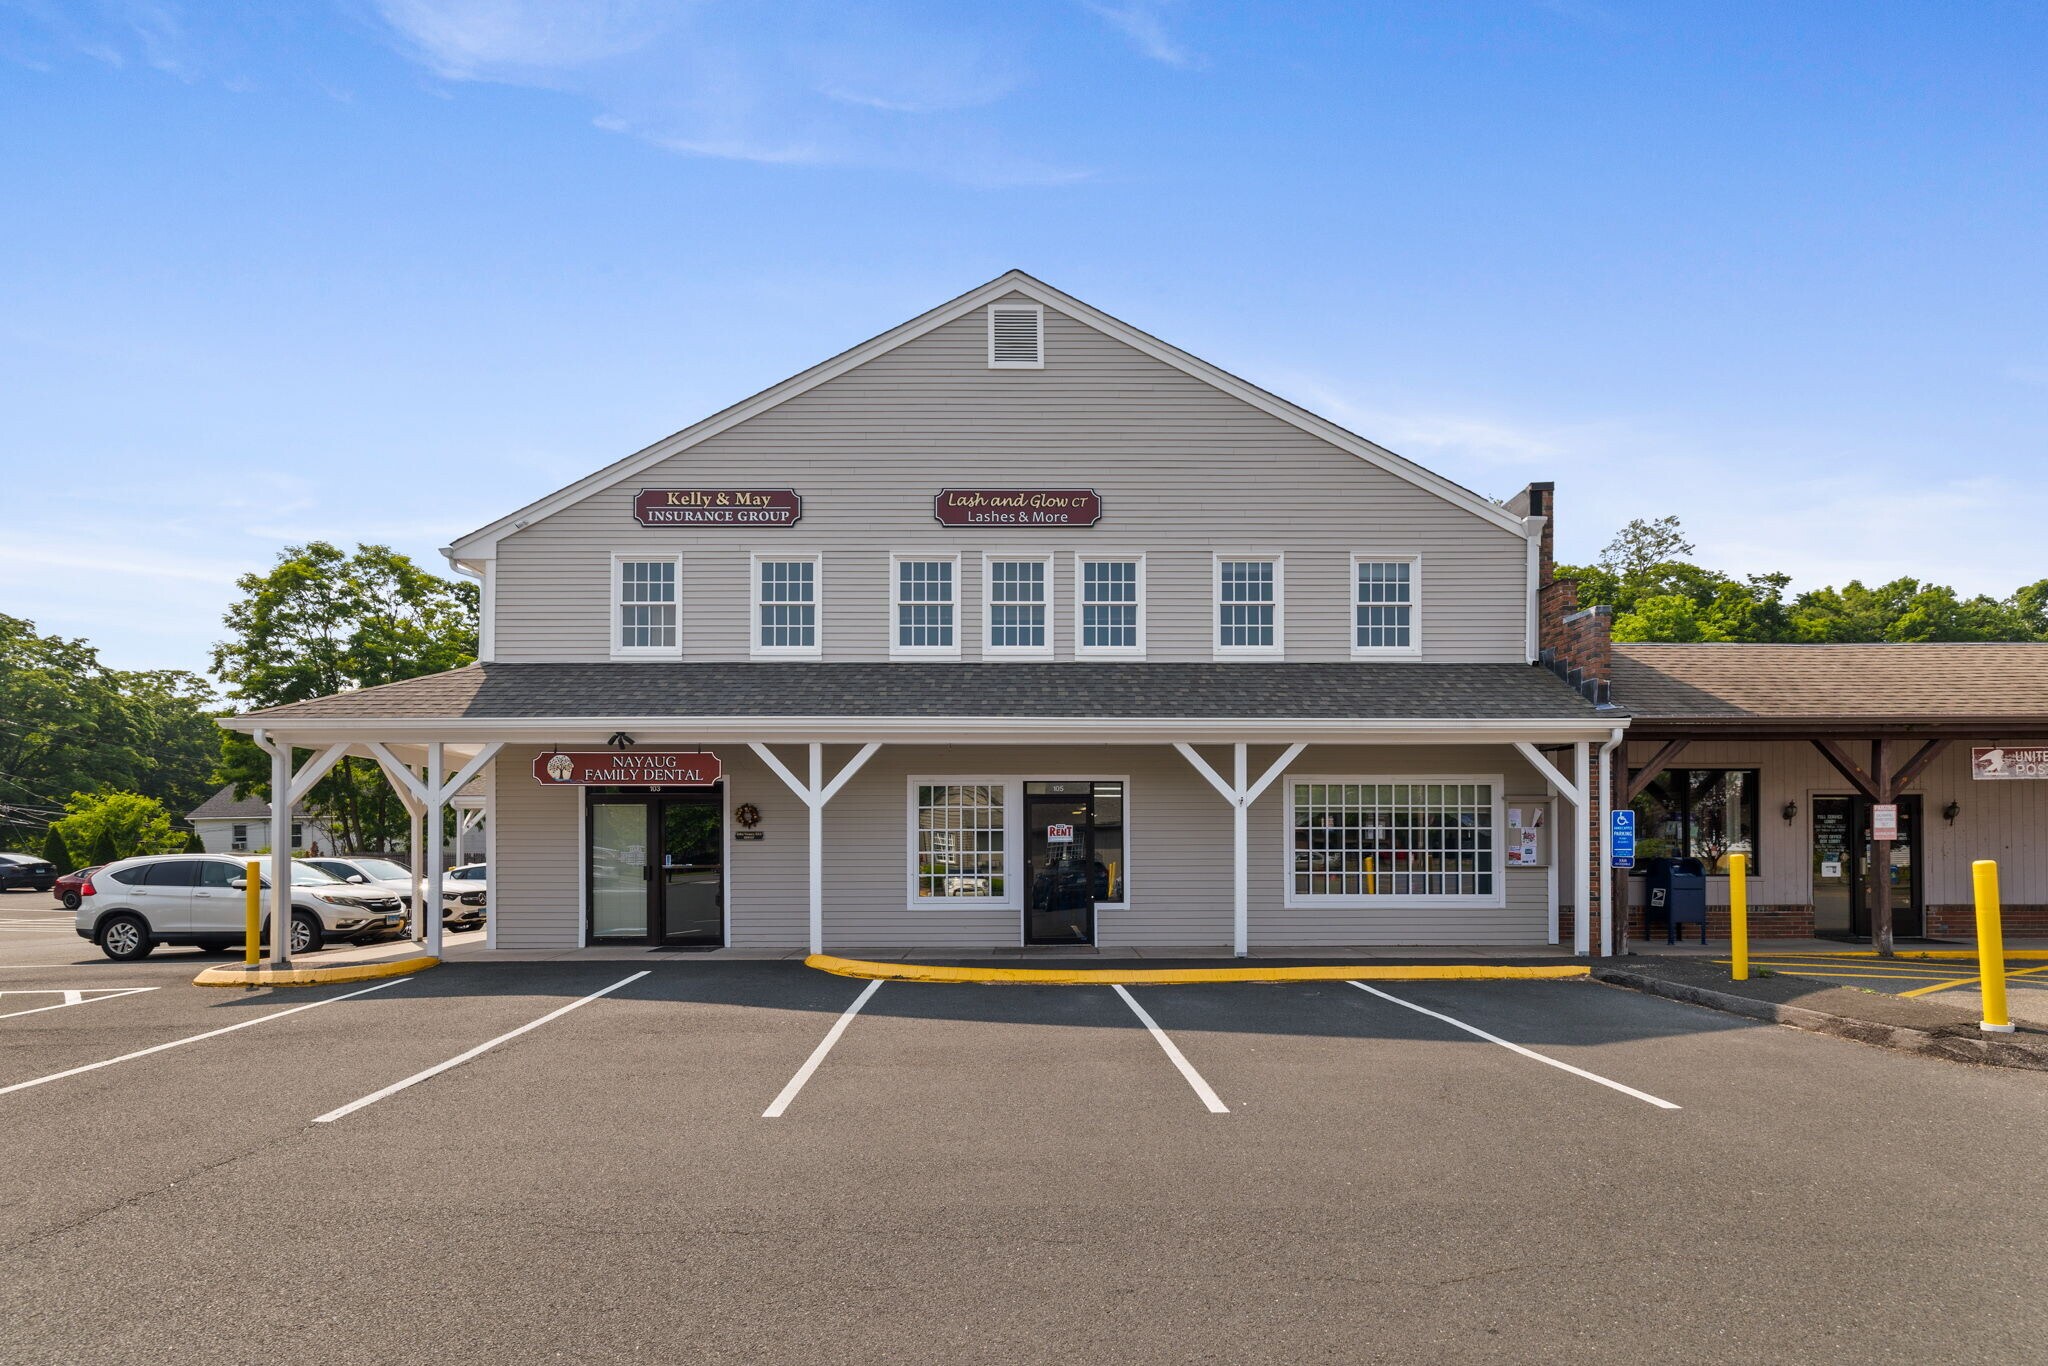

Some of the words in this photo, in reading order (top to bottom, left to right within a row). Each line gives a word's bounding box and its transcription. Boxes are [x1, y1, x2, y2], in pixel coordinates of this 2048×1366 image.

[666, 491, 712, 508] Kelly
[715, 492, 729, 506] &
[735, 492, 771, 508] May
[948, 492, 988, 507] Lash
[990, 493, 1029, 507] and
[1030, 493, 1069, 508] Glow
[1071, 497, 1089, 507] CT
[648, 511, 733, 521] INSURANCE
[737, 511, 790, 522] GROUP
[968, 511, 1015, 523] Lashes
[1018, 511, 1029, 523] &
[1032, 511, 1068, 523] More
[612, 756, 676, 768] NAYAUG
[2015, 751, 2048, 762] UNITE
[2015, 762, 2048, 775] POS
[585, 769, 639, 781] FAMILY
[643, 769, 704, 781] DENTAL
[1050, 826, 1072, 836] RENT
